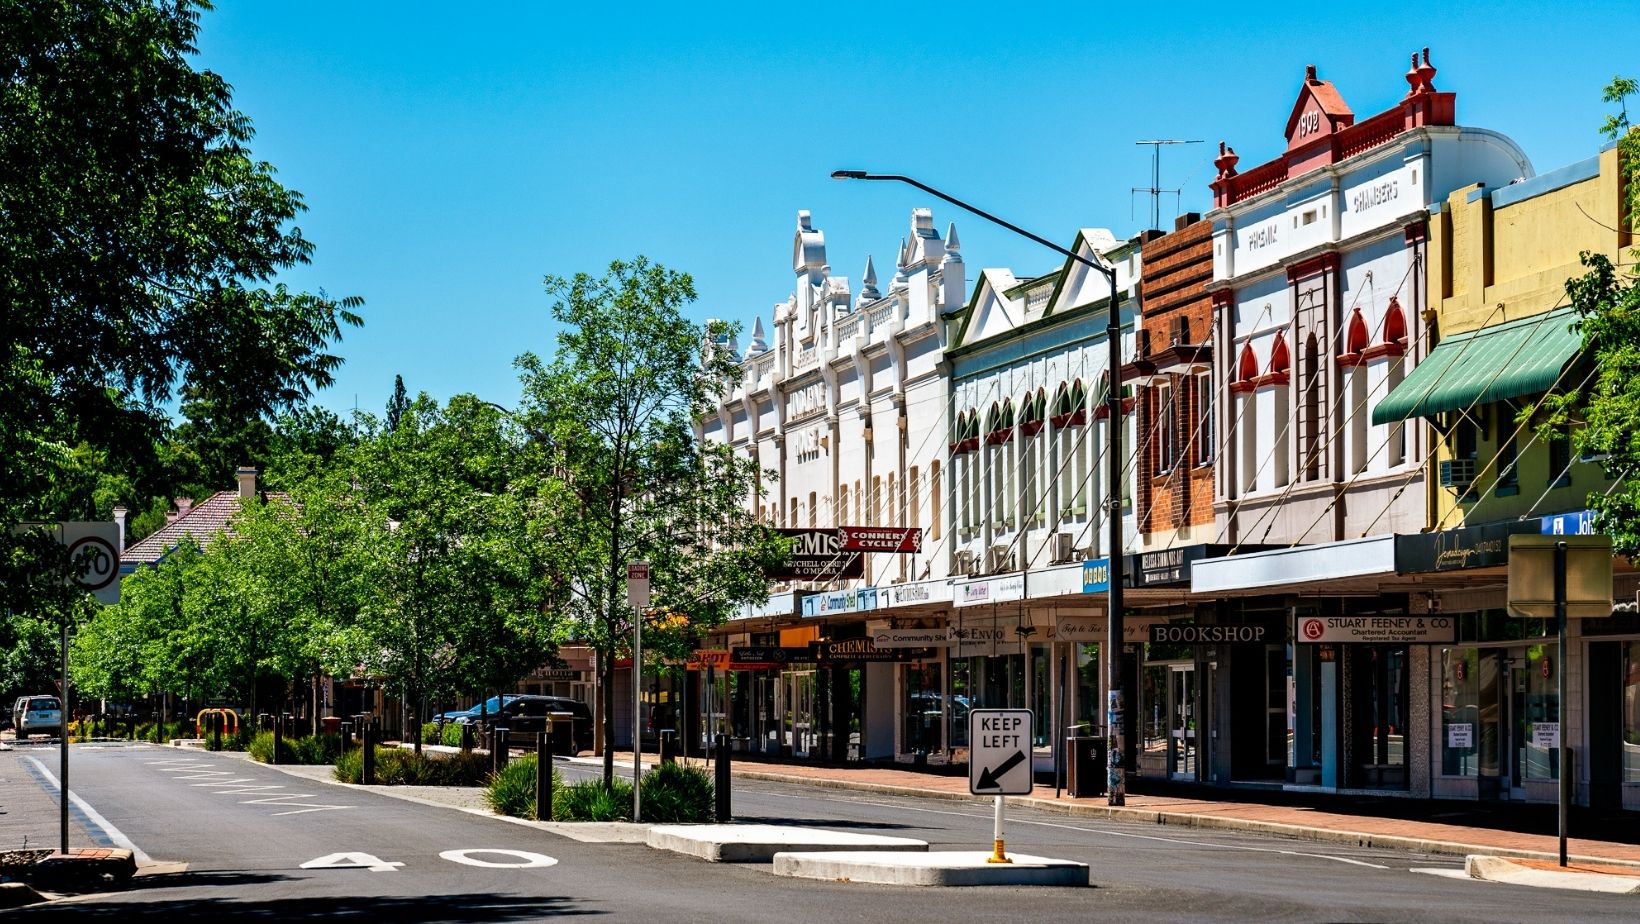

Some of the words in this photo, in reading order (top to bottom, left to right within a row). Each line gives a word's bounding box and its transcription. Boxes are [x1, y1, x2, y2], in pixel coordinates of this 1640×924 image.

[1298, 110, 1320, 138] 1902
[1353, 181, 1399, 214] CHAMBERS
[851, 532, 907, 540] CONNERY
[1328, 618, 1367, 628] STUART
[1371, 618, 1411, 628] FEENEY
[1416, 618, 1425, 628] &
[1431, 618, 1452, 628] CO.
[892, 634, 933, 643] Community
[935, 634, 947, 642] She
[1155, 626, 1265, 642] BOOKSHOP
[981, 717, 1022, 731] KEEP
[983, 735, 1020, 748] LEFT
